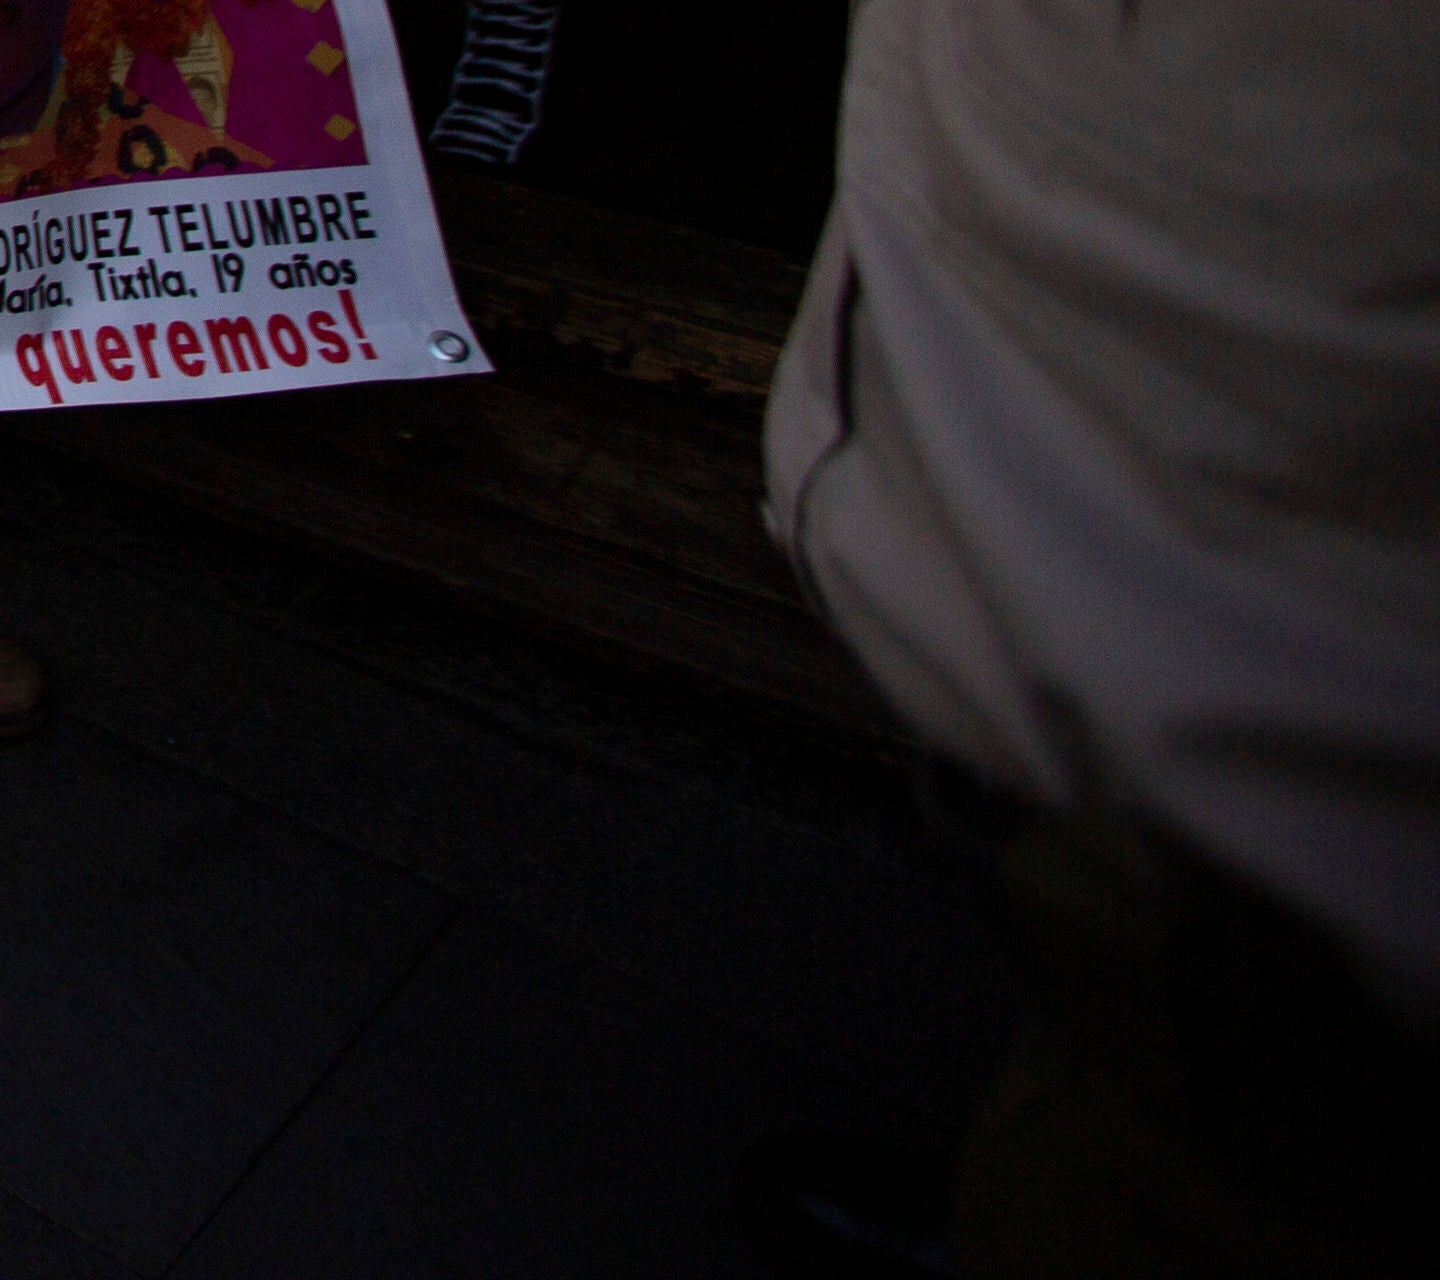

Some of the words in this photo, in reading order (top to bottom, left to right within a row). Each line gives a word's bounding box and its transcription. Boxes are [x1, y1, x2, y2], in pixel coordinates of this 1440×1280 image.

[148, 190, 379, 255] TELUMBRE
[211, 251, 246, 295] 19
[268, 251, 359, 291] años
[14, 288, 379, 406] queremos!
